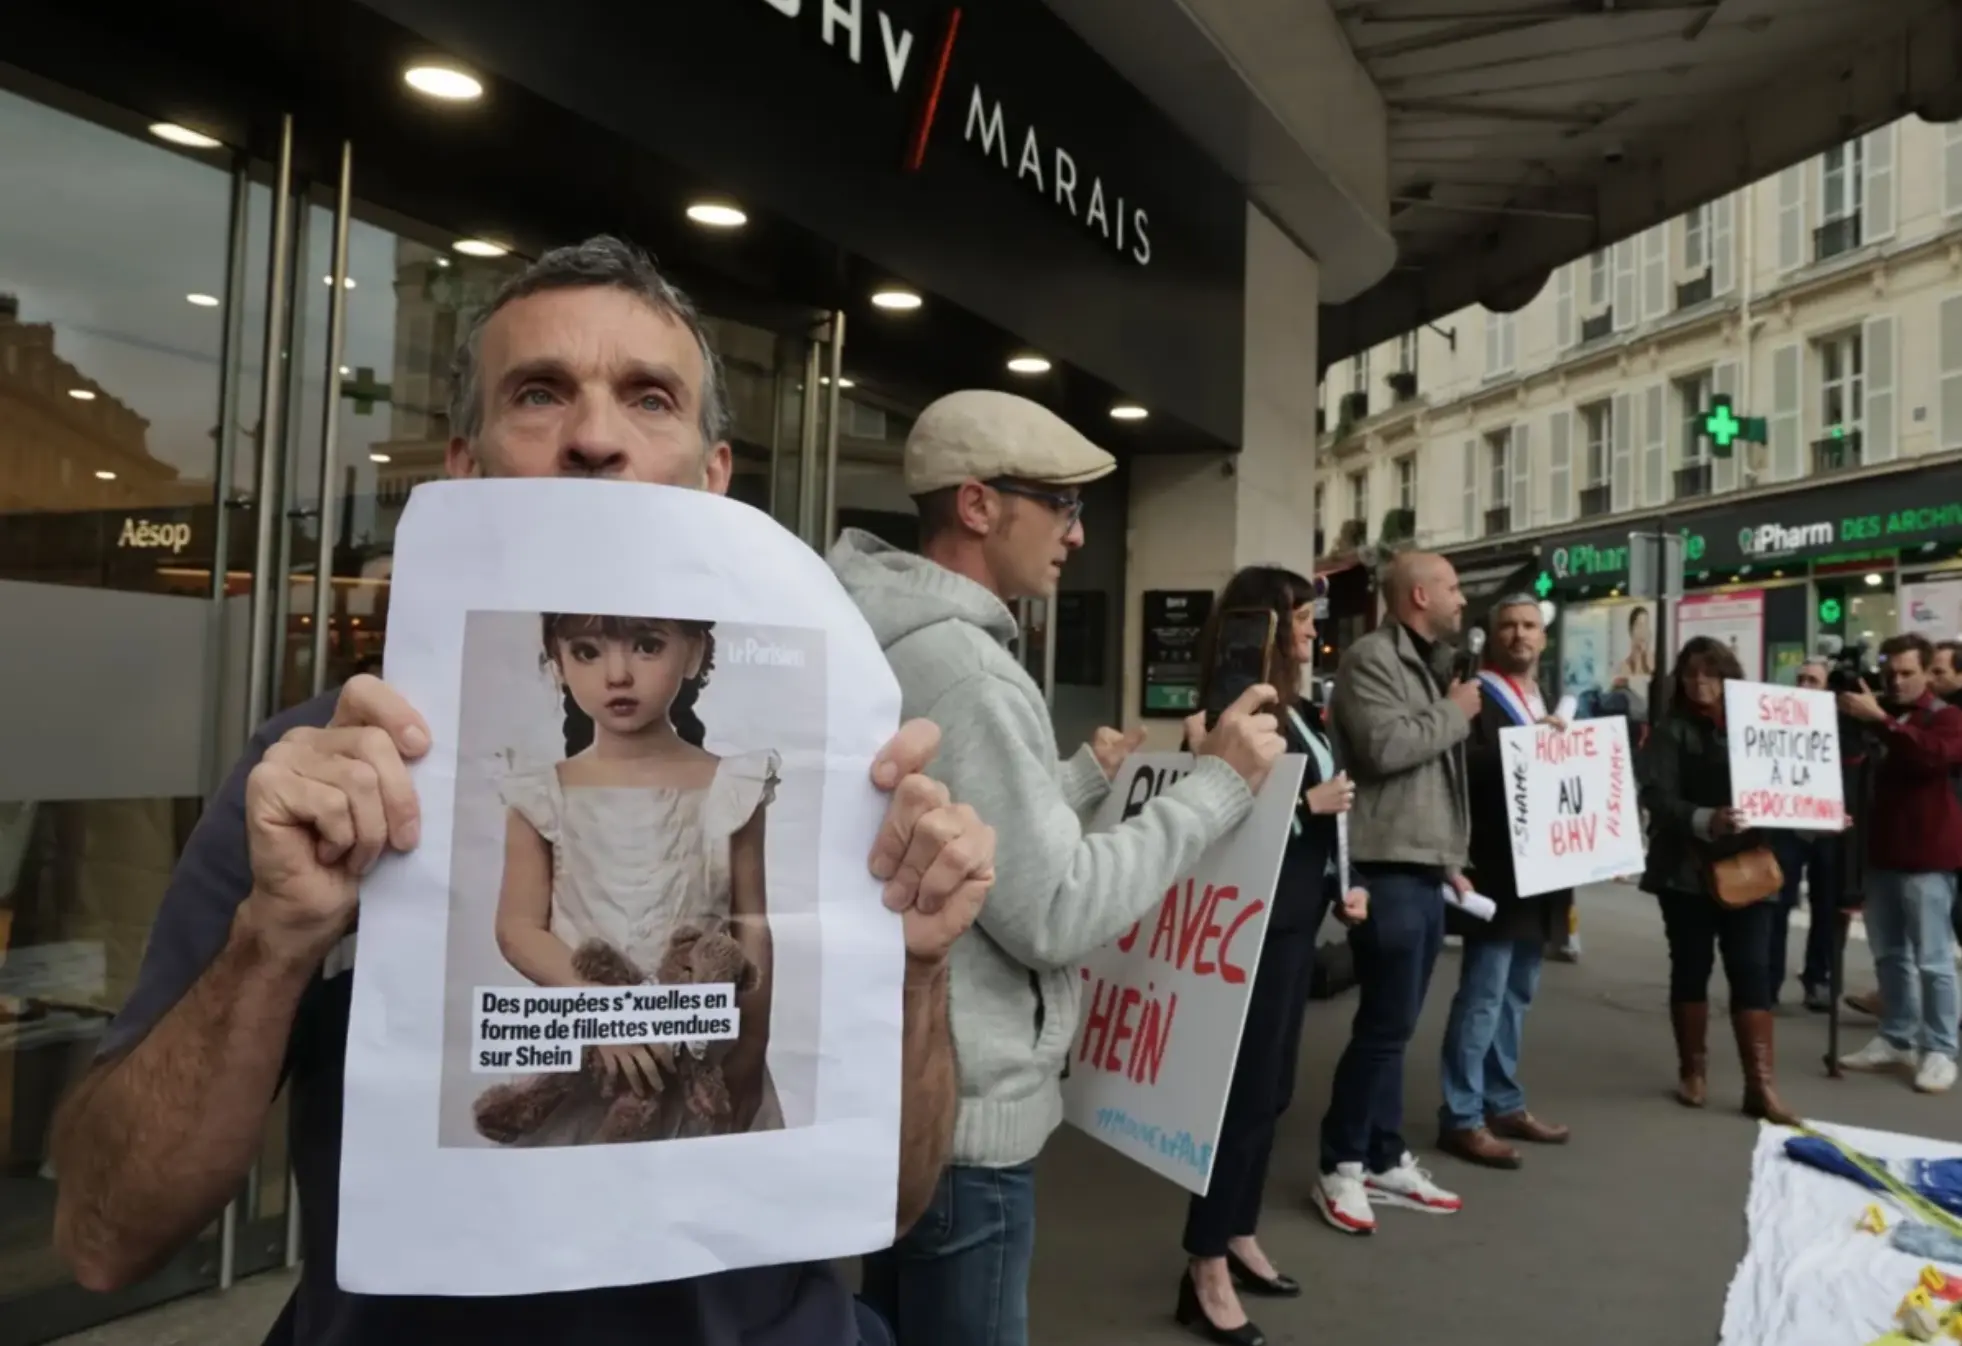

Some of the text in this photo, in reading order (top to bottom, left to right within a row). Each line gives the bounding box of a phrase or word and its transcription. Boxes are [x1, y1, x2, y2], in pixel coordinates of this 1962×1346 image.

[764, 0, 914, 93] HV
[964, 83, 1151, 265] MARAIS
[1840, 514, 1880, 542] DES
[1535, 726, 1598, 766] HONTE
[1744, 725, 1832, 764] PARTICIPE
[1791, 763, 1811, 785] LA
[1558, 775, 1583, 815] AU
[1551, 811, 1598, 857] BHV
[1149, 877, 1265, 984] AVEC
[482, 992, 520, 1014] Des
[524, 992, 610, 1018] poupées
[704, 993, 727, 1009] en
[481, 1014, 731, 1040] forme de fillettes vendues
[479, 1044, 573, 1067] sur Shein
